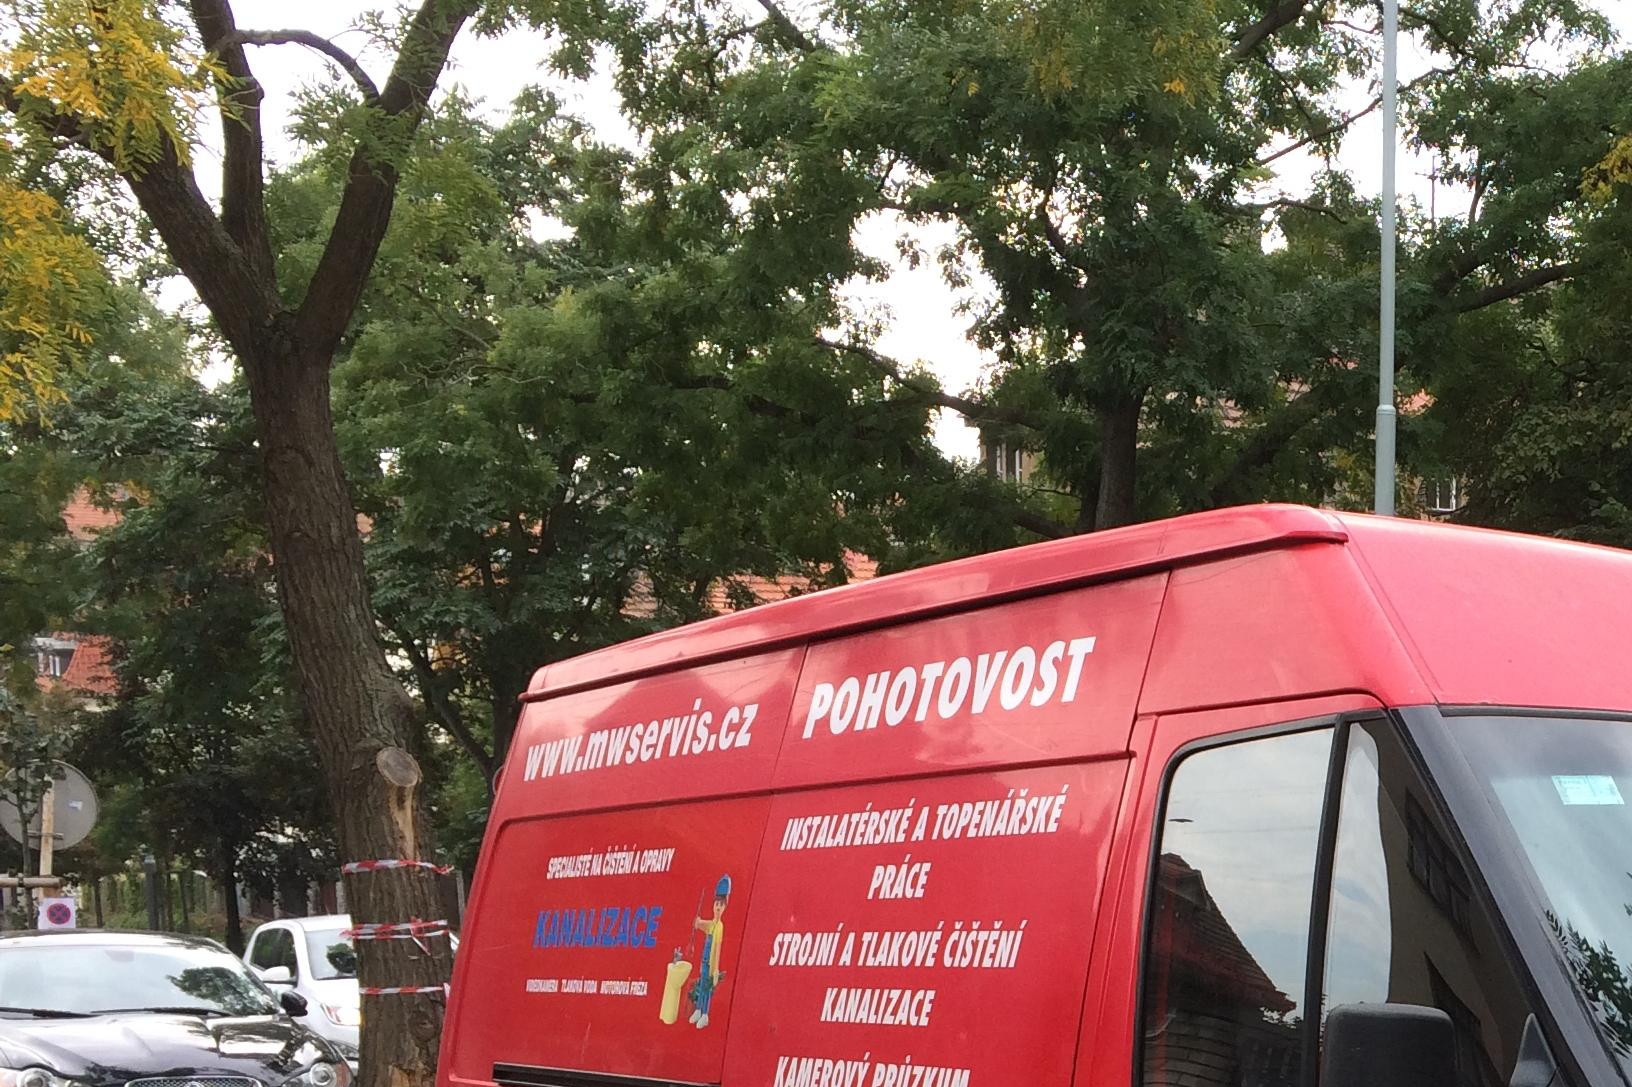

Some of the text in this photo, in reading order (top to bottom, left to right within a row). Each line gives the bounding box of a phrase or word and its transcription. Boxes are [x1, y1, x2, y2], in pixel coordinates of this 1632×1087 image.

[802, 636, 1096, 739] POHOTOVOST
[523, 698, 759, 782] www.mwservis.cz
[780, 784, 1069, 851] INSTALATÉRSKÉ A TOPENÁŘSKÉ
[640, 847, 675, 874] OPRAVY
[867, 853, 931, 900] PRÁCE
[533, 905, 663, 949] KANALIZACE
[768, 919, 1028, 968] STROJNÍ A TLAKOVÉ ČIŠTĚNÍ
[820, 987, 936, 1027] KANALIZACE
